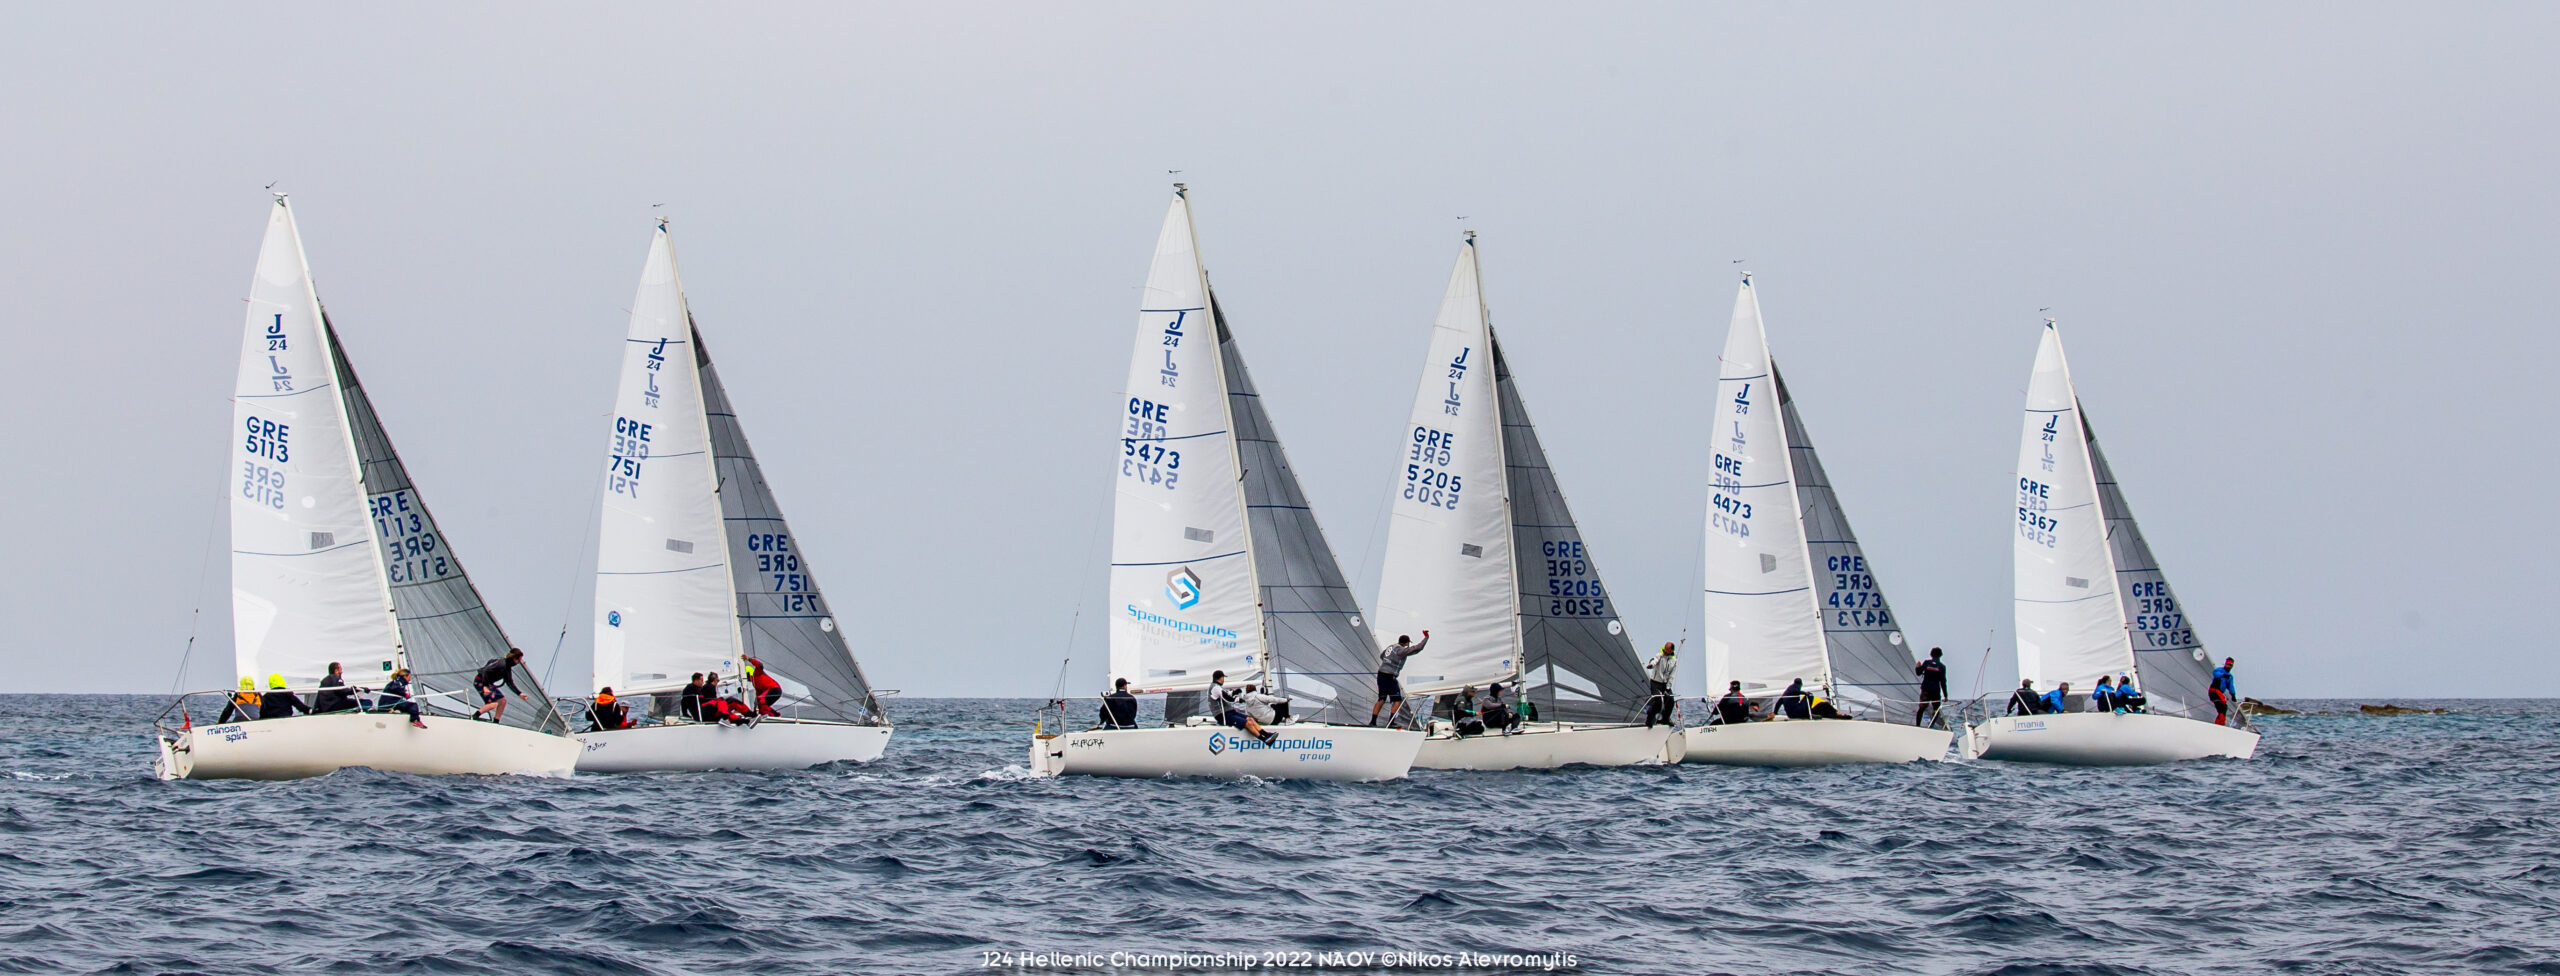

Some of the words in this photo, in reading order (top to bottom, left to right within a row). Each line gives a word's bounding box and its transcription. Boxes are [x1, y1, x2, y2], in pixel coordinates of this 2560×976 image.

[268, 314, 282, 334] J
[1168, 311, 1186, 330] J
[269, 339, 287, 351] 24
[651, 337, 668, 355] J
[1163, 335, 1179, 347] 24
[1455, 347, 1470, 365] J
[646, 359, 661, 372] 24
[1448, 368, 1463, 380] 24
[1737, 383, 1750, 399] J
[1129, 397, 1169, 424] GRE
[1735, 405, 1748, 415] 24
[246, 416, 289, 443] GRE
[616, 416, 652, 443] GRE
[2046, 415, 2058, 429] J
[1413, 426, 1454, 450] GRE
[2042, 433, 2054, 442] 24
[245, 435, 289, 463] 5113
[1125, 438, 1180, 470] 5473
[610, 455, 641, 480] 751
[1715, 453, 1742, 477] GRE
[1407, 464, 1462, 493] 5205
[2020, 477, 2050, 499] GRE
[1713, 493, 1752, 519] 4473
[378, 513, 422, 538] 113
[2019, 507, 2057, 533] 5367
[748, 534, 788, 551] GRE
[1542, 541, 1582, 558] GRE
[1827, 556, 1864, 572] GRE
[774, 574, 808, 592] 751
[1549, 580, 1601, 597] 5205
[2132, 581, 2165, 598] GRE
[1829, 592, 1882, 608] 4473
[1128, 604, 1237, 639] Spanopoulos
[2136, 613, 2182, 631] 5367
[1200, 637, 1237, 649] group
[206, 725, 241, 736] minoan
[1299, 753, 1331, 762] group
